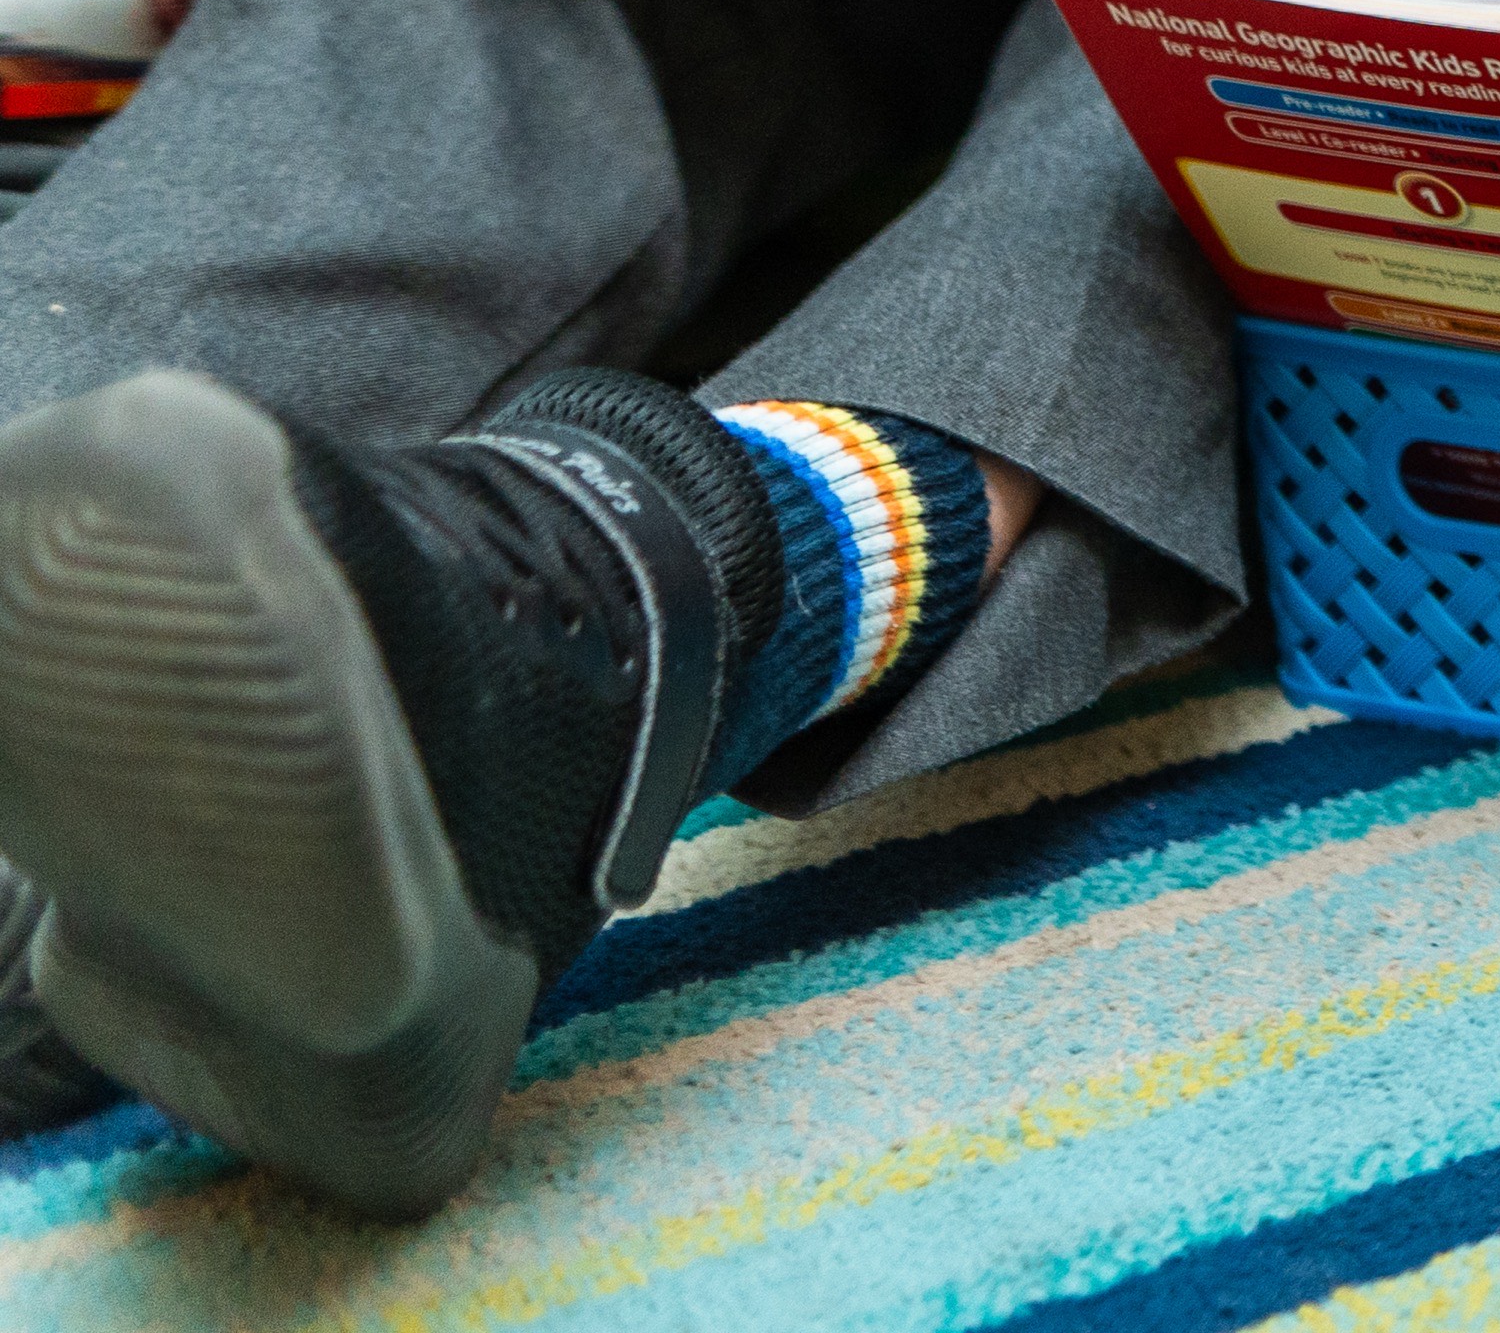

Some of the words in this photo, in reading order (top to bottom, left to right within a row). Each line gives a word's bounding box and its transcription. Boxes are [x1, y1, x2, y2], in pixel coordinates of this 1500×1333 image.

[1107, 3, 1234, 41] National
[1233, 21, 1407, 67] Geographic
[1409, 49, 1482, 77] Kids
[1159, 36, 1195, 58] for
[1198, 46, 1281, 71] curious
[1282, 57, 1332, 79] kids
[1334, 67, 1362, 84] at
[1361, 72, 1425, 96] every
[1282, 94, 1371, 119] Pre-reader
[1418, 186, 1445, 215] 1
